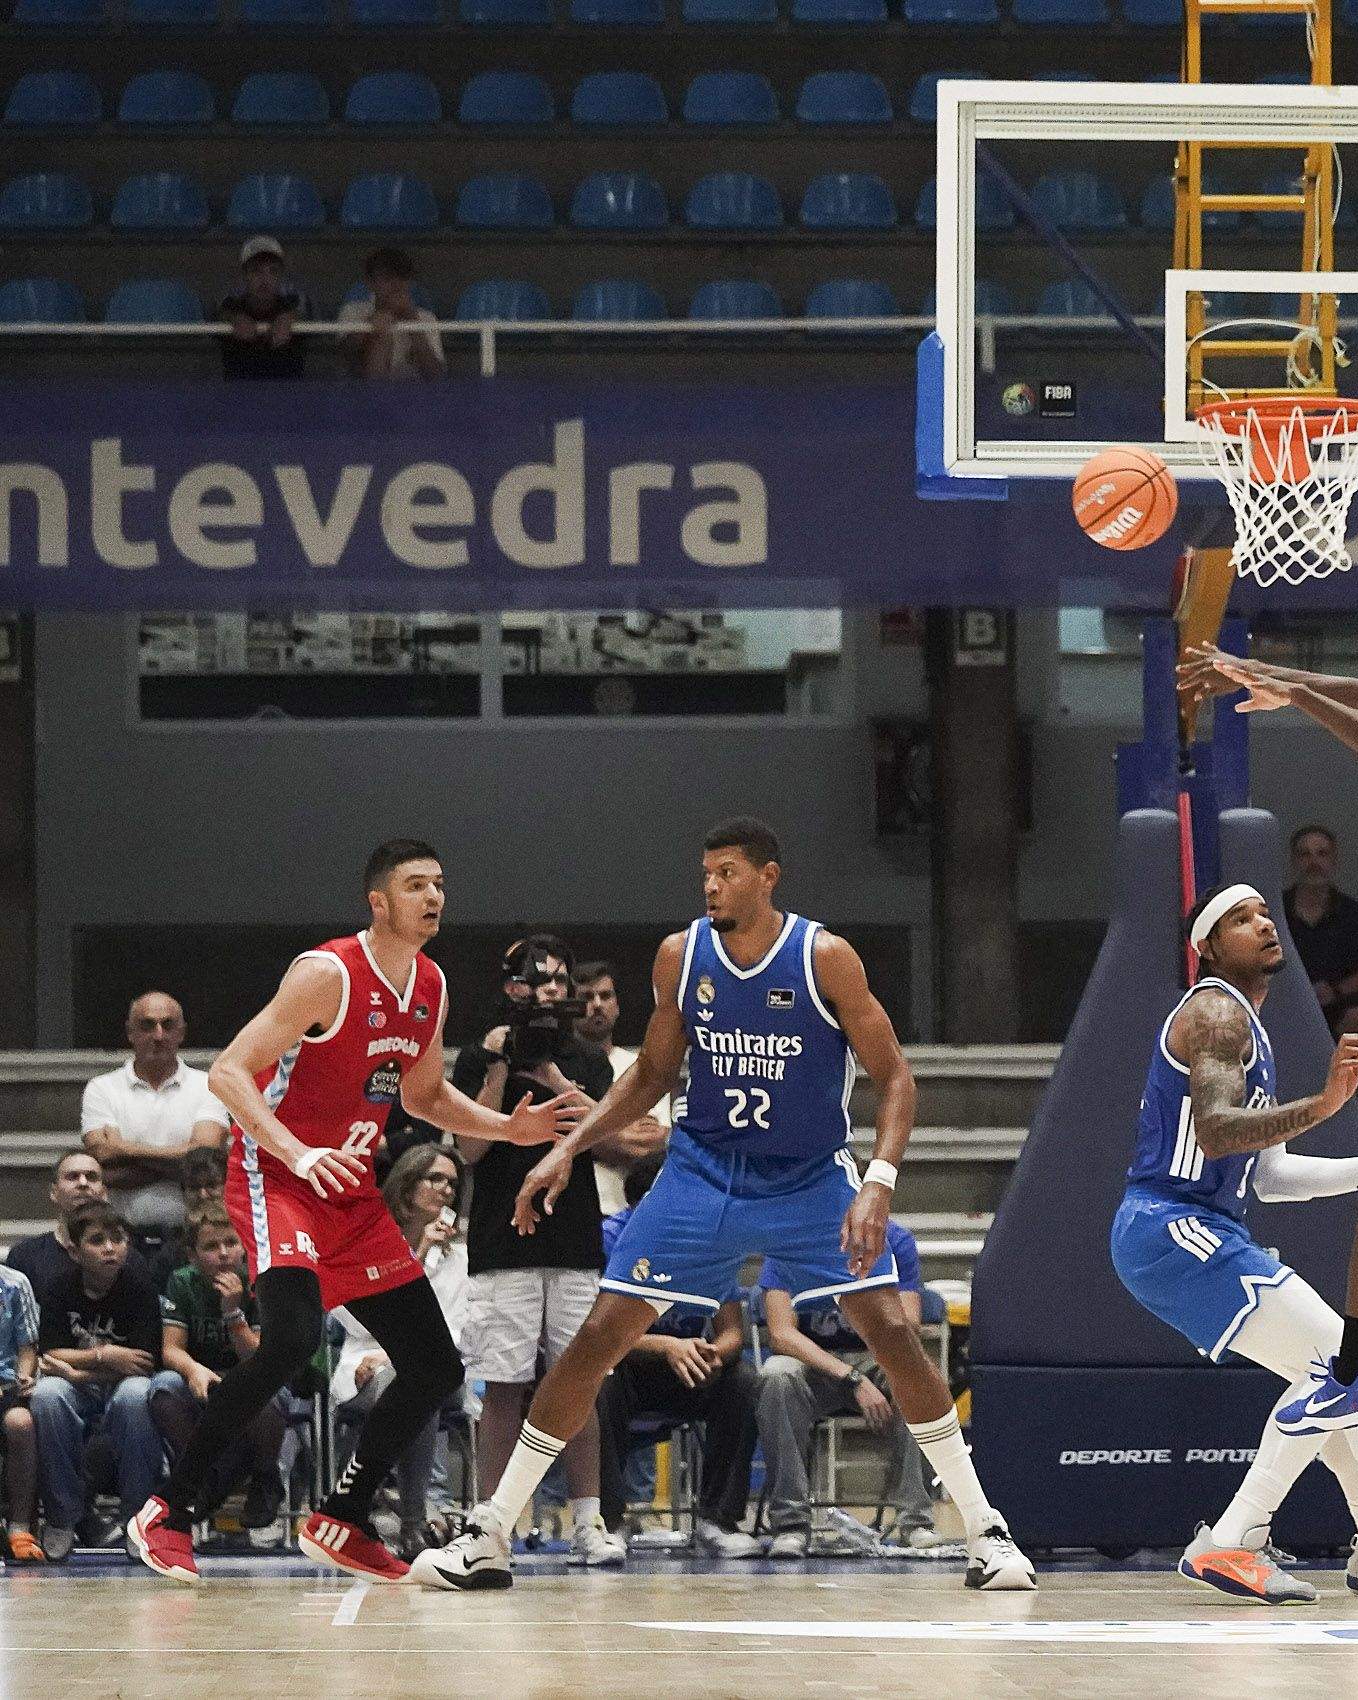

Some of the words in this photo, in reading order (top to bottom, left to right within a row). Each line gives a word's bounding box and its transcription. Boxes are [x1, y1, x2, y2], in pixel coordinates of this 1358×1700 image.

[694, 1025, 803, 1057] Emirates
[712, 1055, 734, 1077] FLY
[738, 1056, 786, 1081] BETTER
[724, 1087, 771, 1130] 22
[341, 1120, 379, 1157] 22
[1059, 1448, 1172, 1465] DEPORTE
